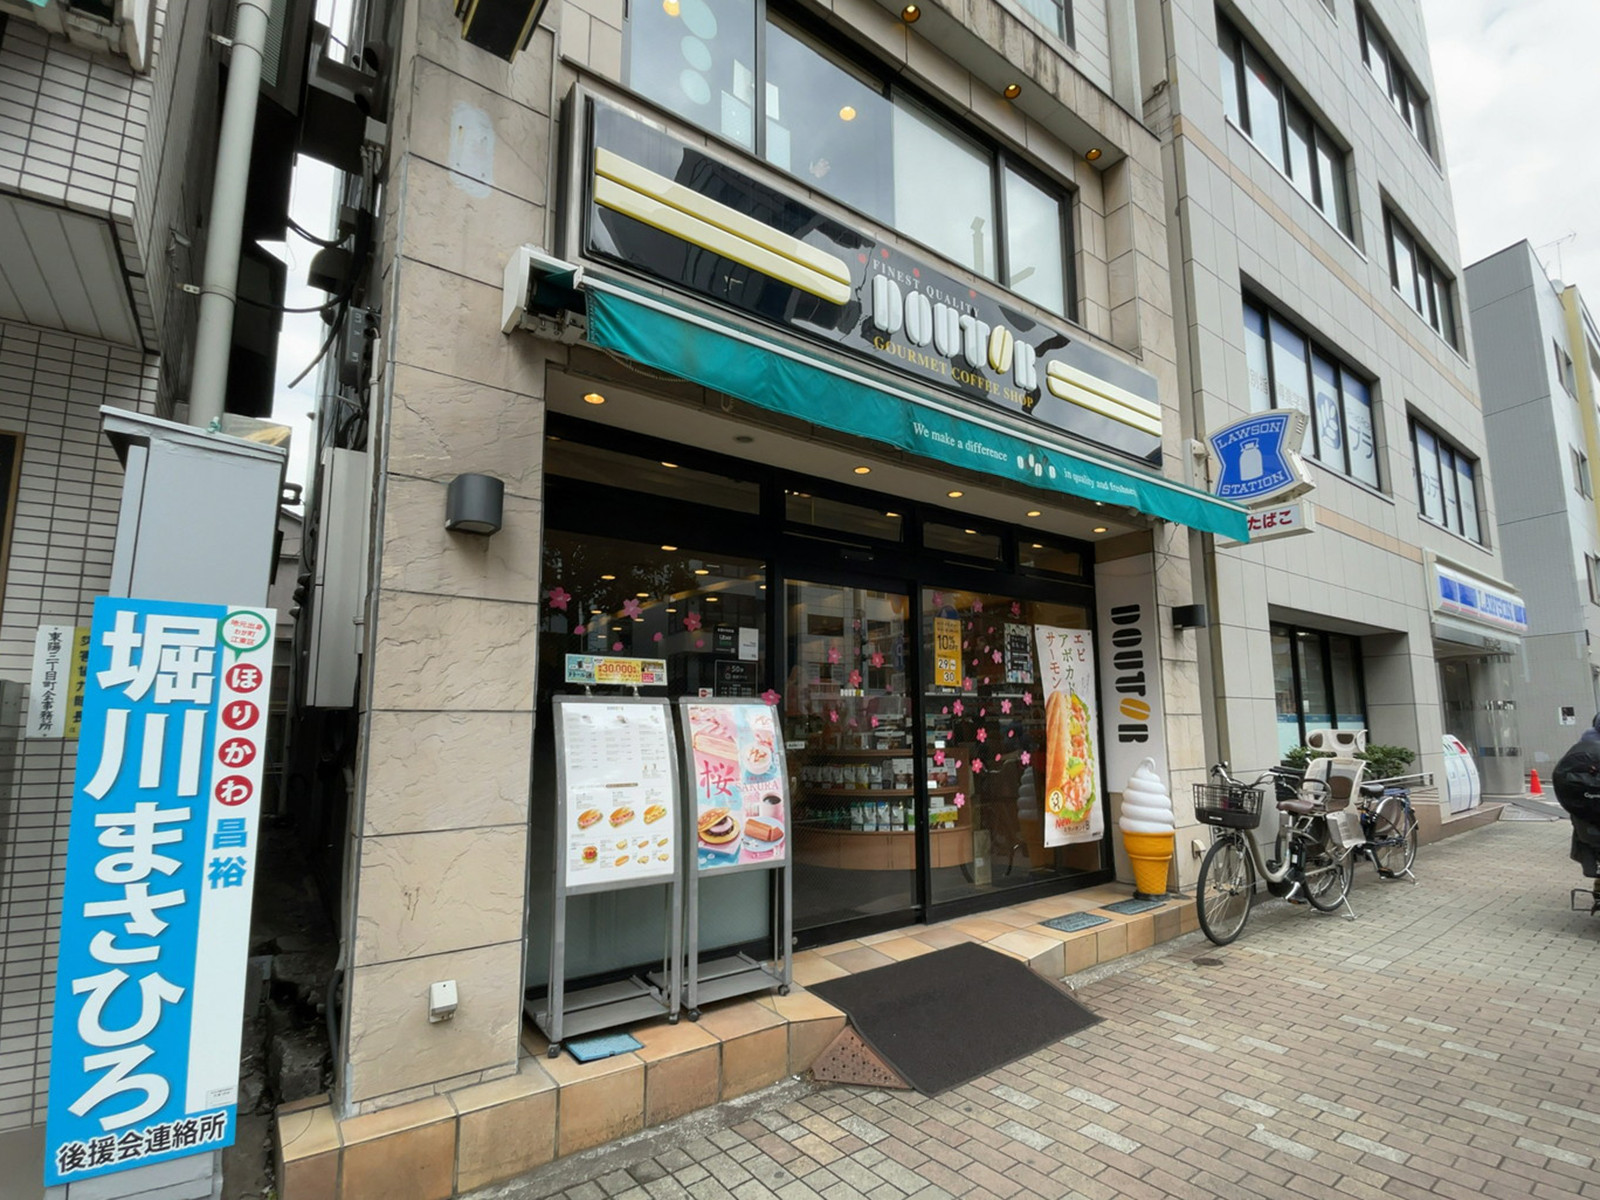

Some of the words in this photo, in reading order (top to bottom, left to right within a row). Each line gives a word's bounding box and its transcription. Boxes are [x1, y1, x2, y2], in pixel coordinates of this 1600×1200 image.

[872, 258, 920, 290] FINEST
[926, 286, 980, 317] QUALITY
[872, 274, 1037, 392] DOUTOR
[873, 336, 947, 375] GOURMET
[951, 366, 1000, 395] COFFEE
[1003, 387, 1034, 408] SHOP
[913, 422, 929, 438] We
[931, 430, 956, 446] make
[957, 439, 963, 450] a
[965, 440, 1008, 462] difference
[1217, 421, 1282, 449] LAWSON
[1063, 467, 1072, 479] in
[1072, 472, 1095, 488] quality
[1096, 480, 1109, 490] and
[1221, 470, 1285, 495] STATION
[1247, 510, 1293, 531] たばこ
[1477, 589, 1515, 622] LAWSON
[1045, 631, 1061, 689] サーモン
[1058, 633, 1075, 697] アボカド
[1074, 634, 1086, 662] エビ
[1110, 604, 1151, 743] DOUTOR
[221, 666, 260, 803] ほりかわ
[699, 760, 735, 799] 桜
[735, 780, 779, 794] SAKURA
[66, 610, 220, 1133] 堀川まさひろ
[207, 817, 248, 890] 昌裕
[58, 1111, 227, 1174] 後援会連絡所
